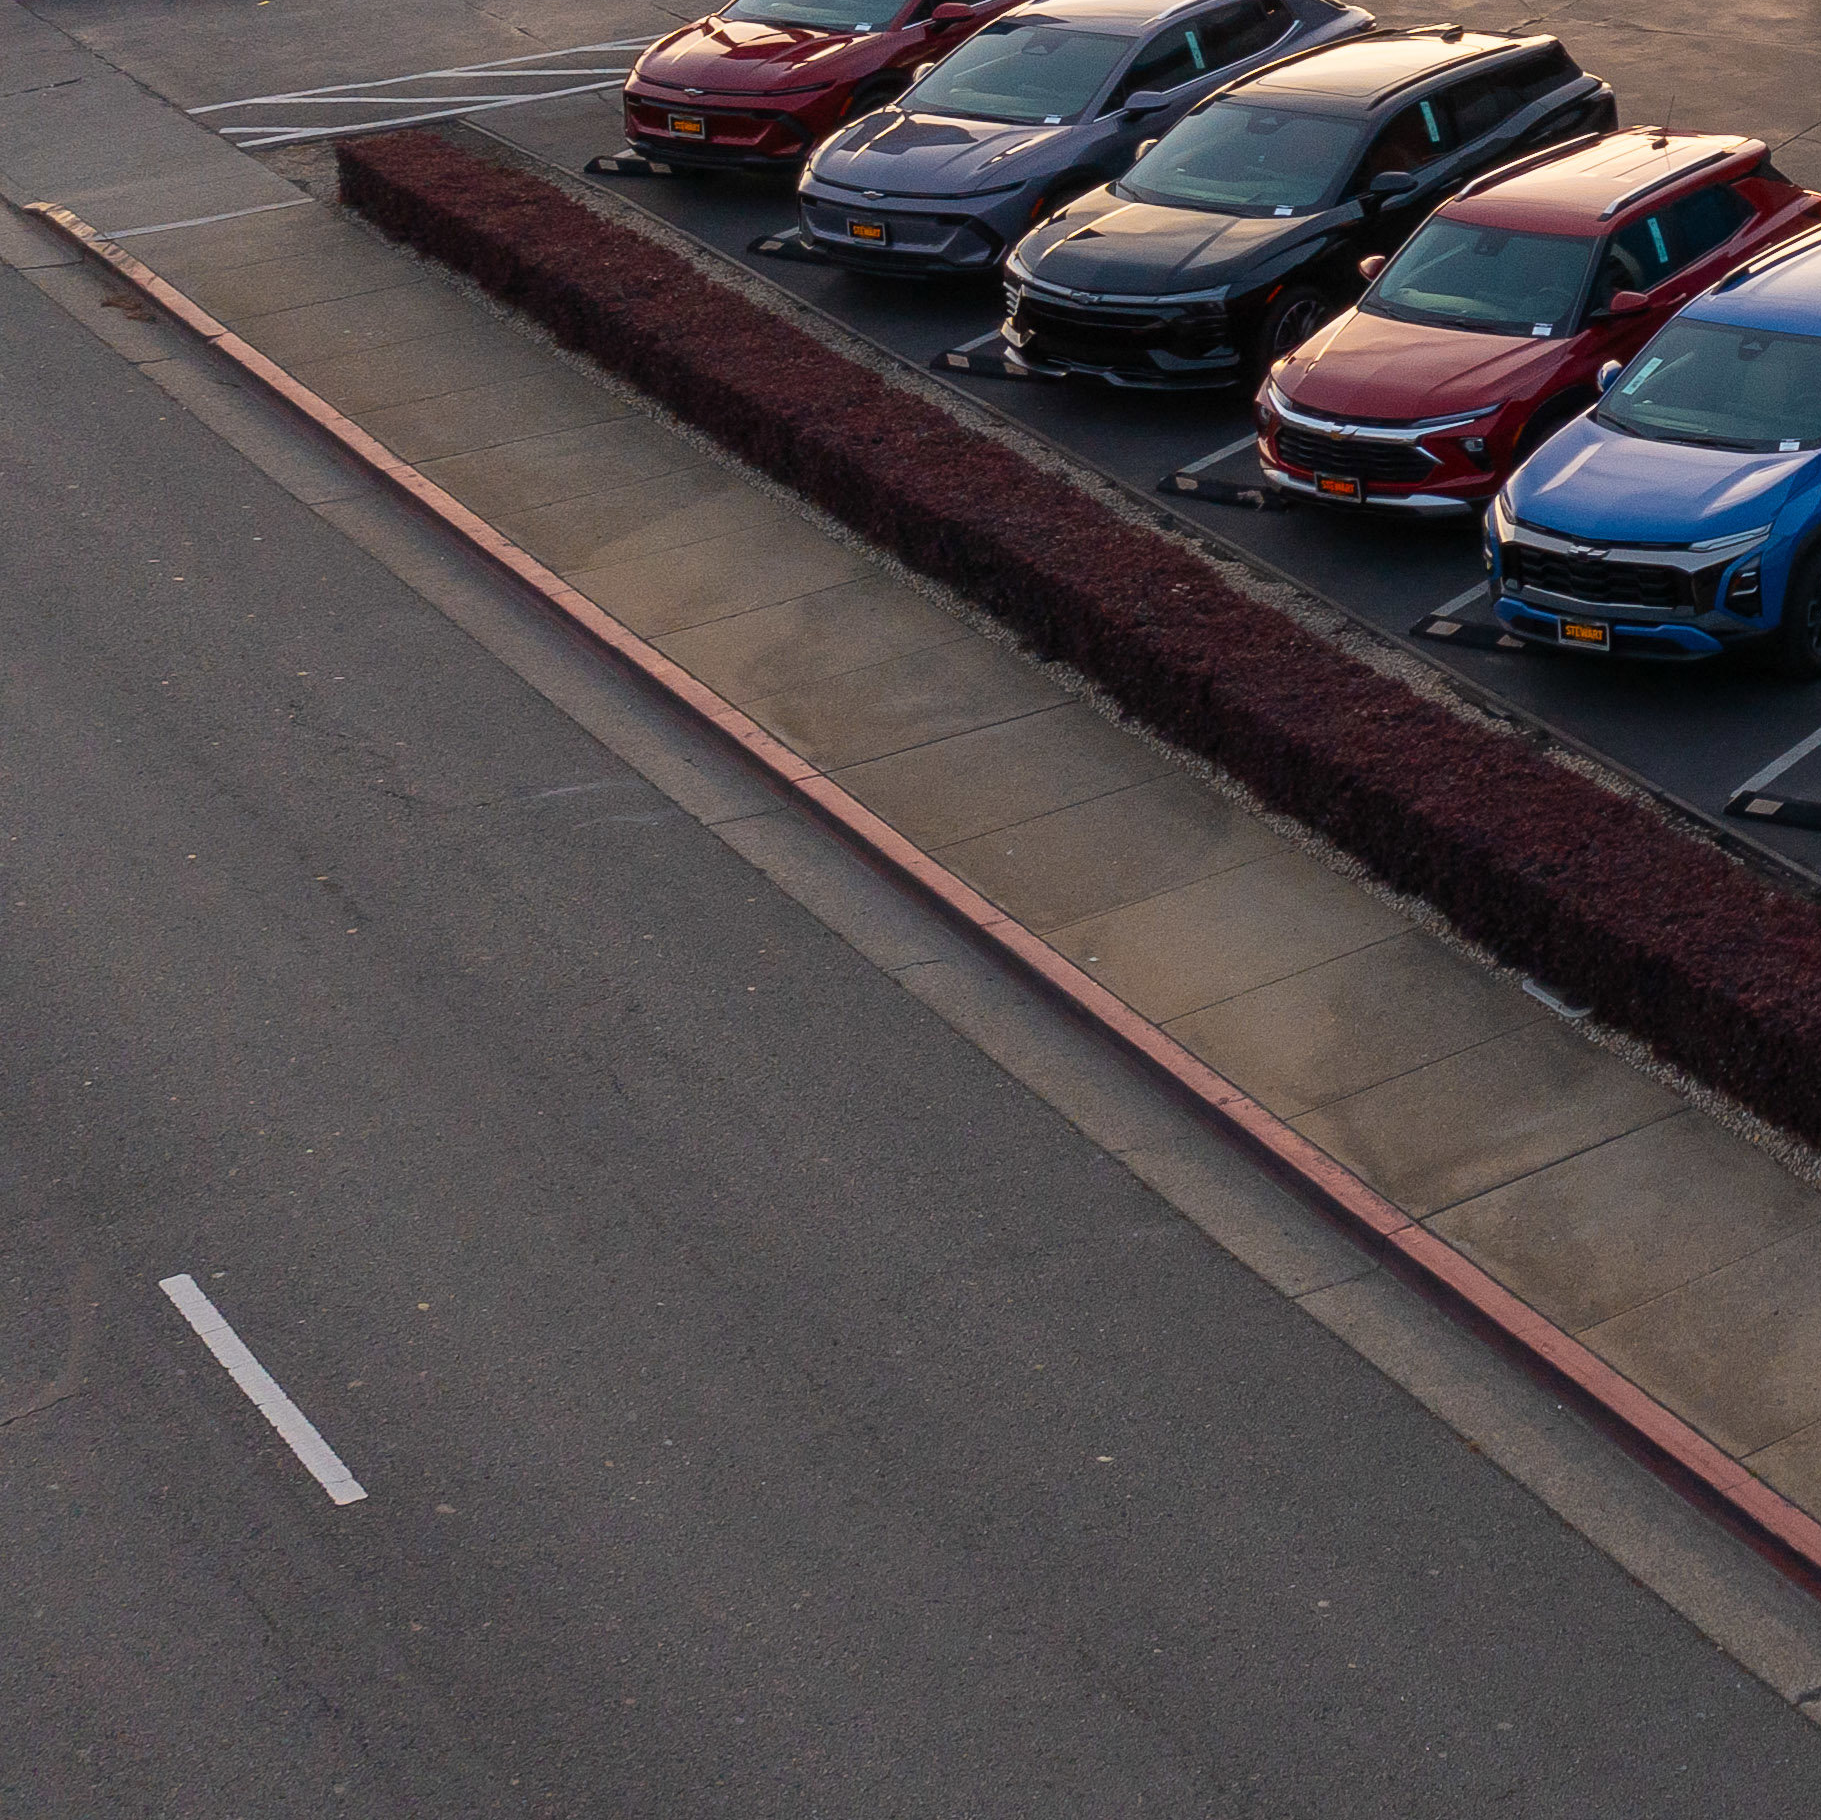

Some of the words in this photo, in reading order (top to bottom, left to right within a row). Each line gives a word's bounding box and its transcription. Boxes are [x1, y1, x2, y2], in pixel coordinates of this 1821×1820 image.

[674, 121, 701, 133] STEWART
[853, 225, 881, 238] STEWART
[1321, 479, 1355, 494] STEWART
[1565, 624, 1604, 642] STEWART
